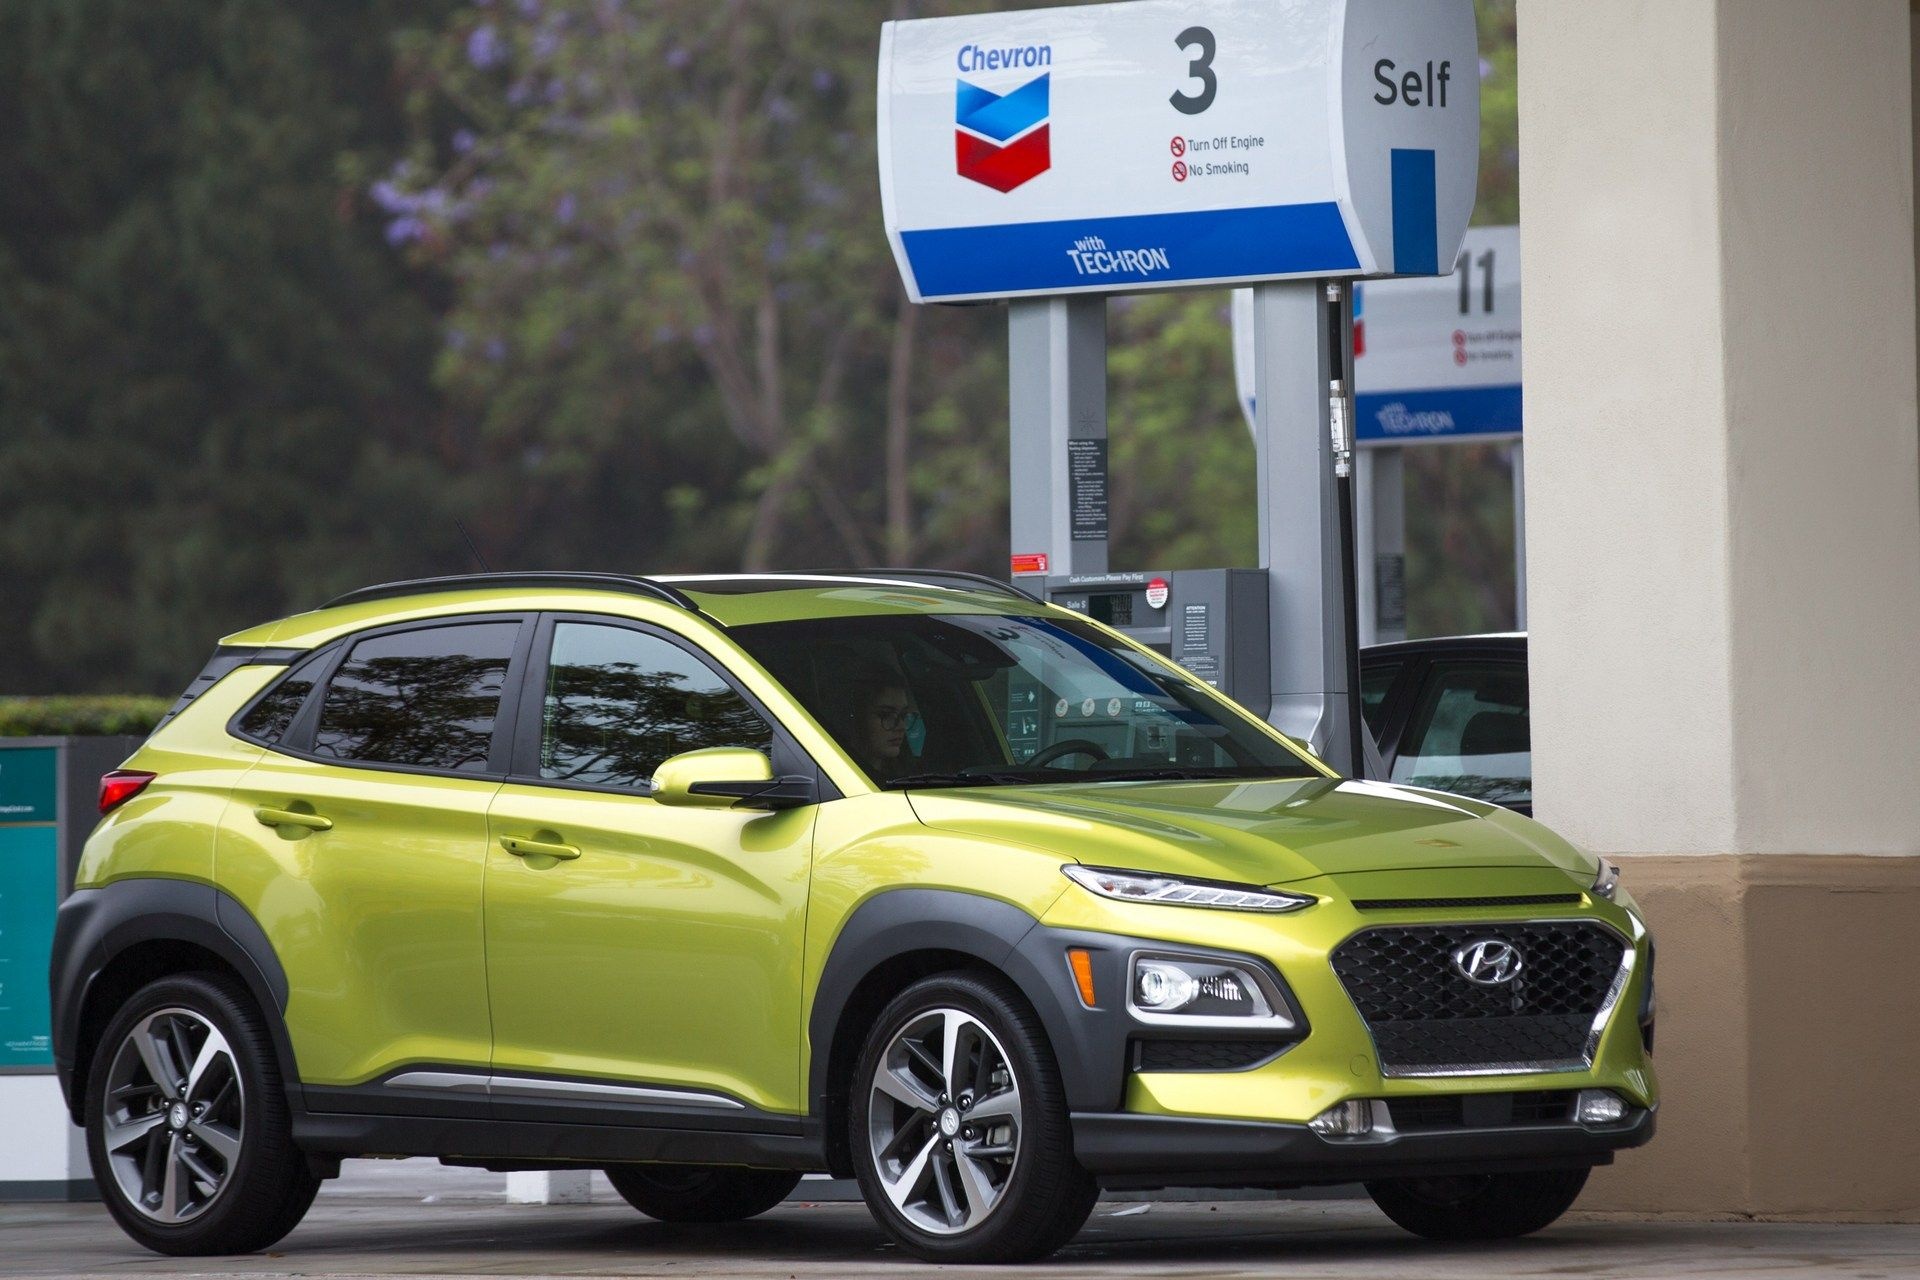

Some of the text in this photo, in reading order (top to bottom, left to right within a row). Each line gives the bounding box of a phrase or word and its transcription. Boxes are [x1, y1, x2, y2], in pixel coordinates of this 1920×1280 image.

[957, 45, 1051, 72] Chevron
[1169, 26, 1217, 115] 3
[1374, 58, 1451, 107] Self
[1188, 135, 1265, 151] Turn Off Engine
[1189, 161, 1249, 176] No Smoking
[1074, 235, 1106, 251] with
[1066, 247, 1171, 276] TECHRON
[1456, 248, 1496, 315] 11
[1080, 575, 1105, 583] Customers
[1122, 573, 1131, 581] Pay
[1066, 600, 1086, 608] Sale $
